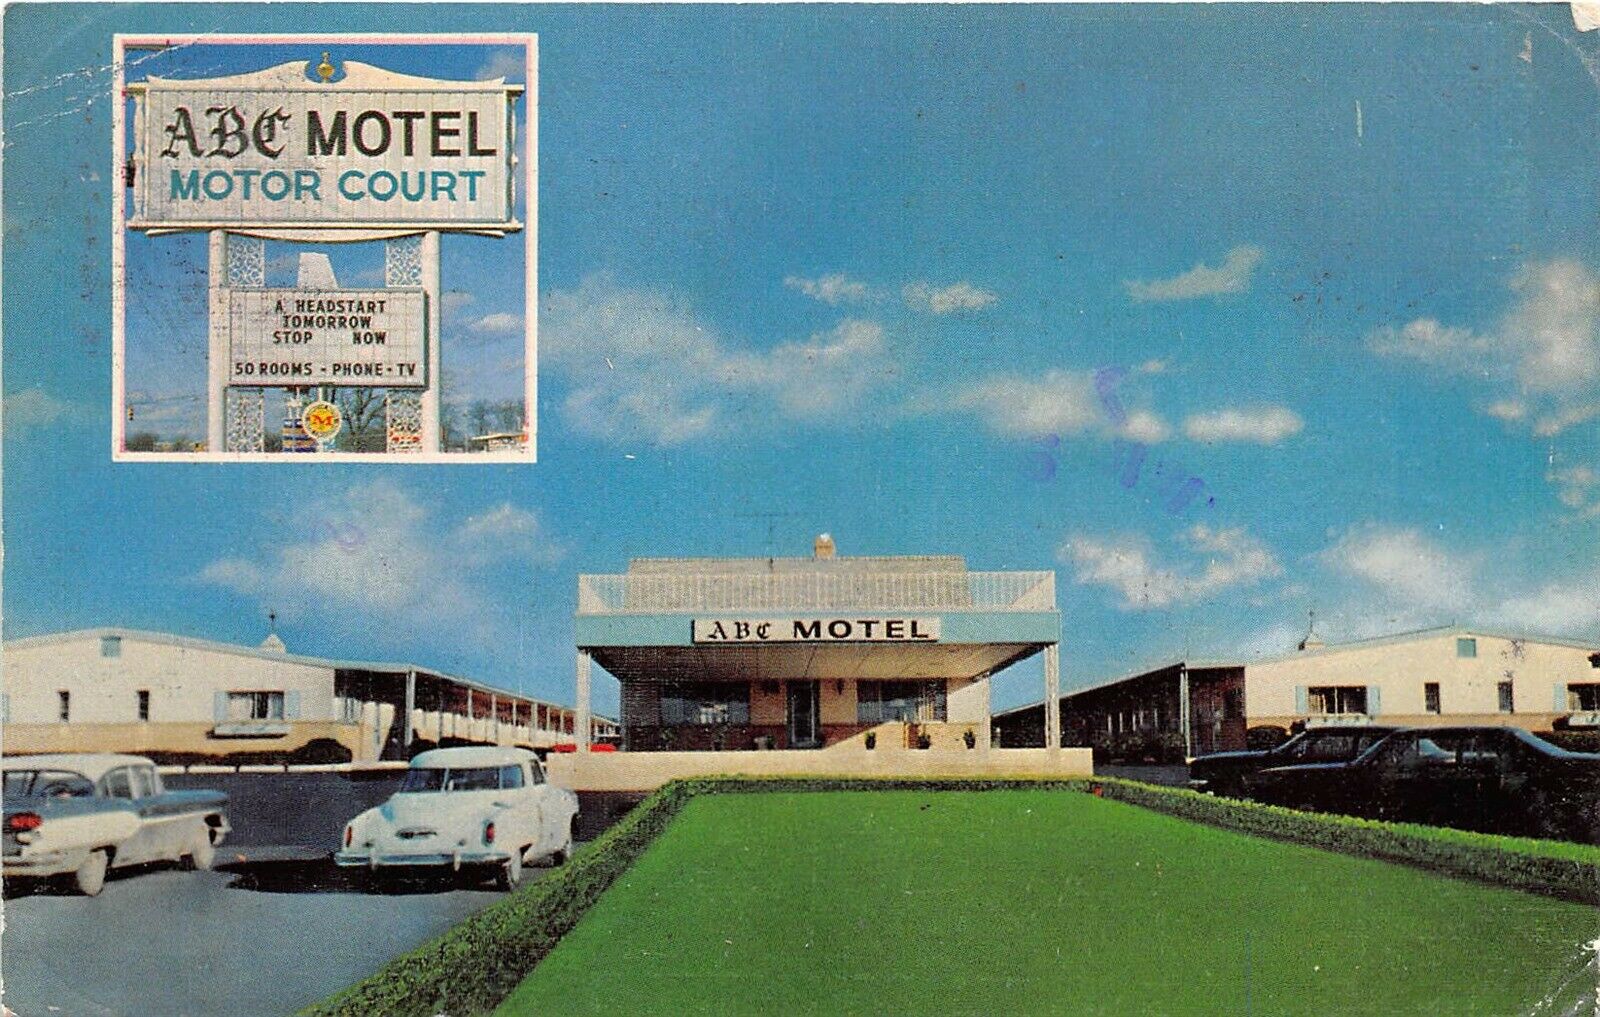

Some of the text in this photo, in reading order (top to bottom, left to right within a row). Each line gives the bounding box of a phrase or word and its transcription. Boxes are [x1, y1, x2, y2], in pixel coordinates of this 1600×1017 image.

[160, 104, 497, 159] ABC MOTEL
[170, 168, 486, 202] MOTOR COURT
[275, 300, 386, 313] A HEADSTART
[283, 315, 372, 329] TOMORROW
[273, 331, 387, 345] STOP NOW
[235, 363, 255, 376] 50
[259, 363, 313, 376] ROOMS
[332, 363, 383, 376] PHONE
[397, 363, 416, 376] TV
[707, 620, 930, 640] ABC MOTEL
